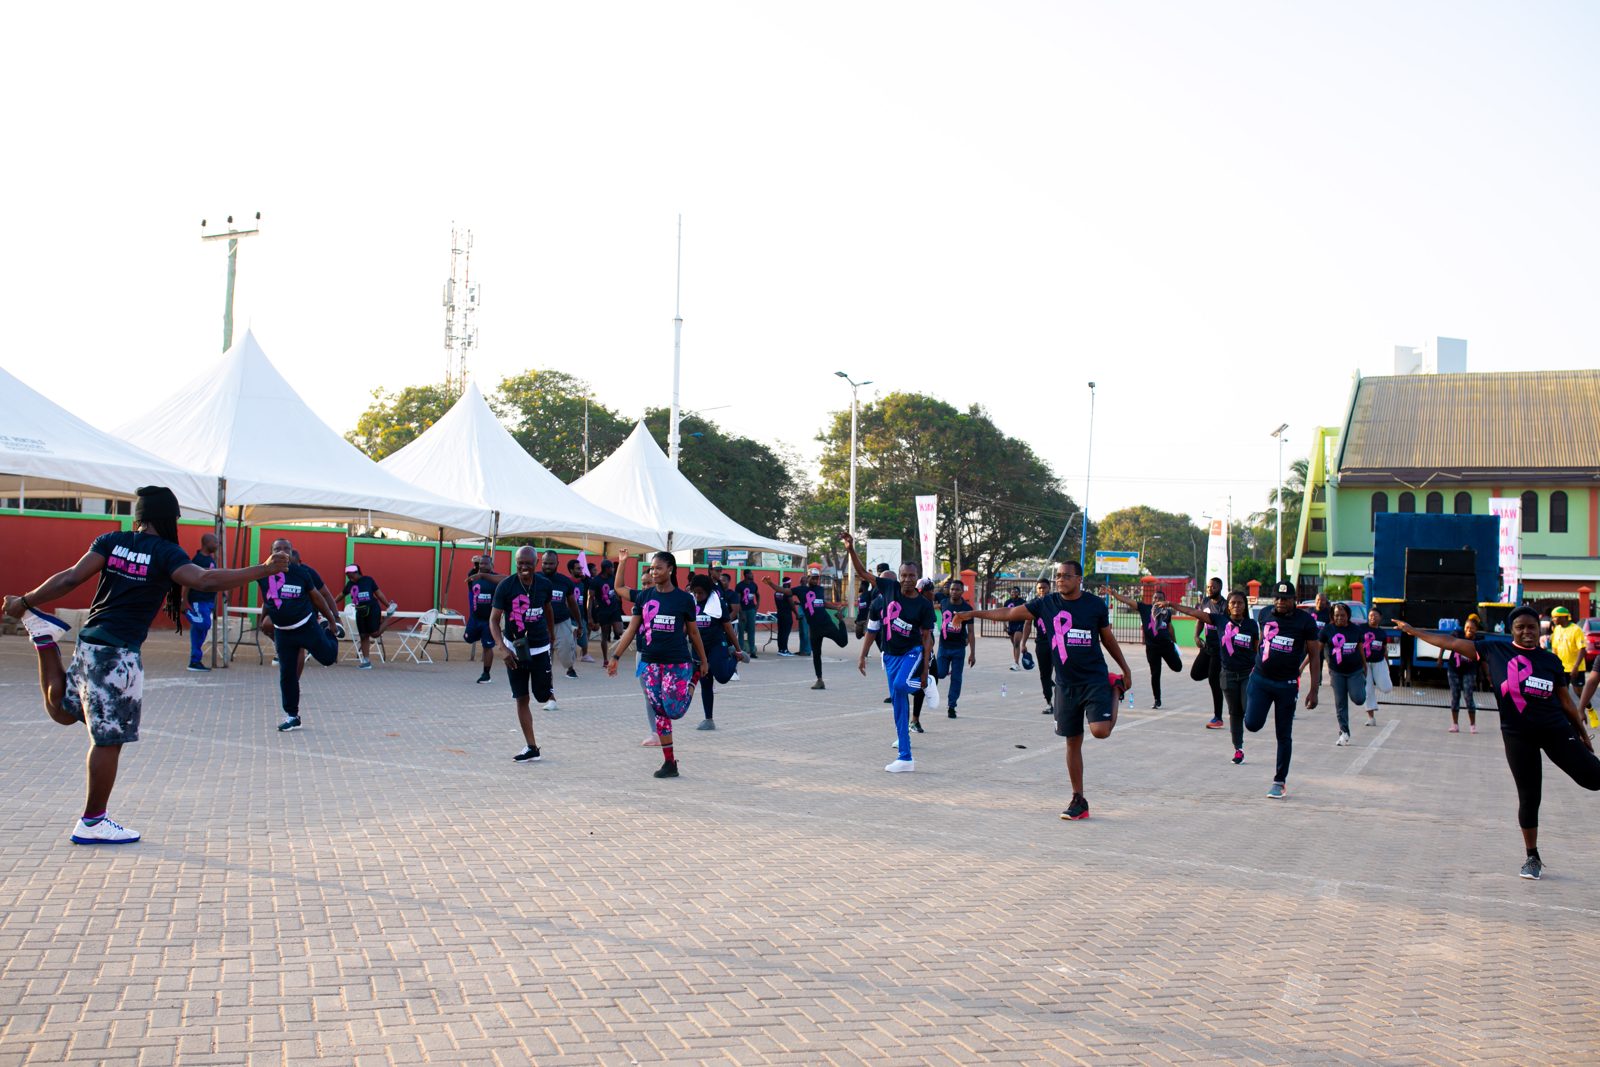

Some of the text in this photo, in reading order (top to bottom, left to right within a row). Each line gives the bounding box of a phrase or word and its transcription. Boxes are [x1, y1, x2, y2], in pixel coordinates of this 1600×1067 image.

[108, 556, 127, 572] PIN
[112, 545, 151, 565] WK IN
